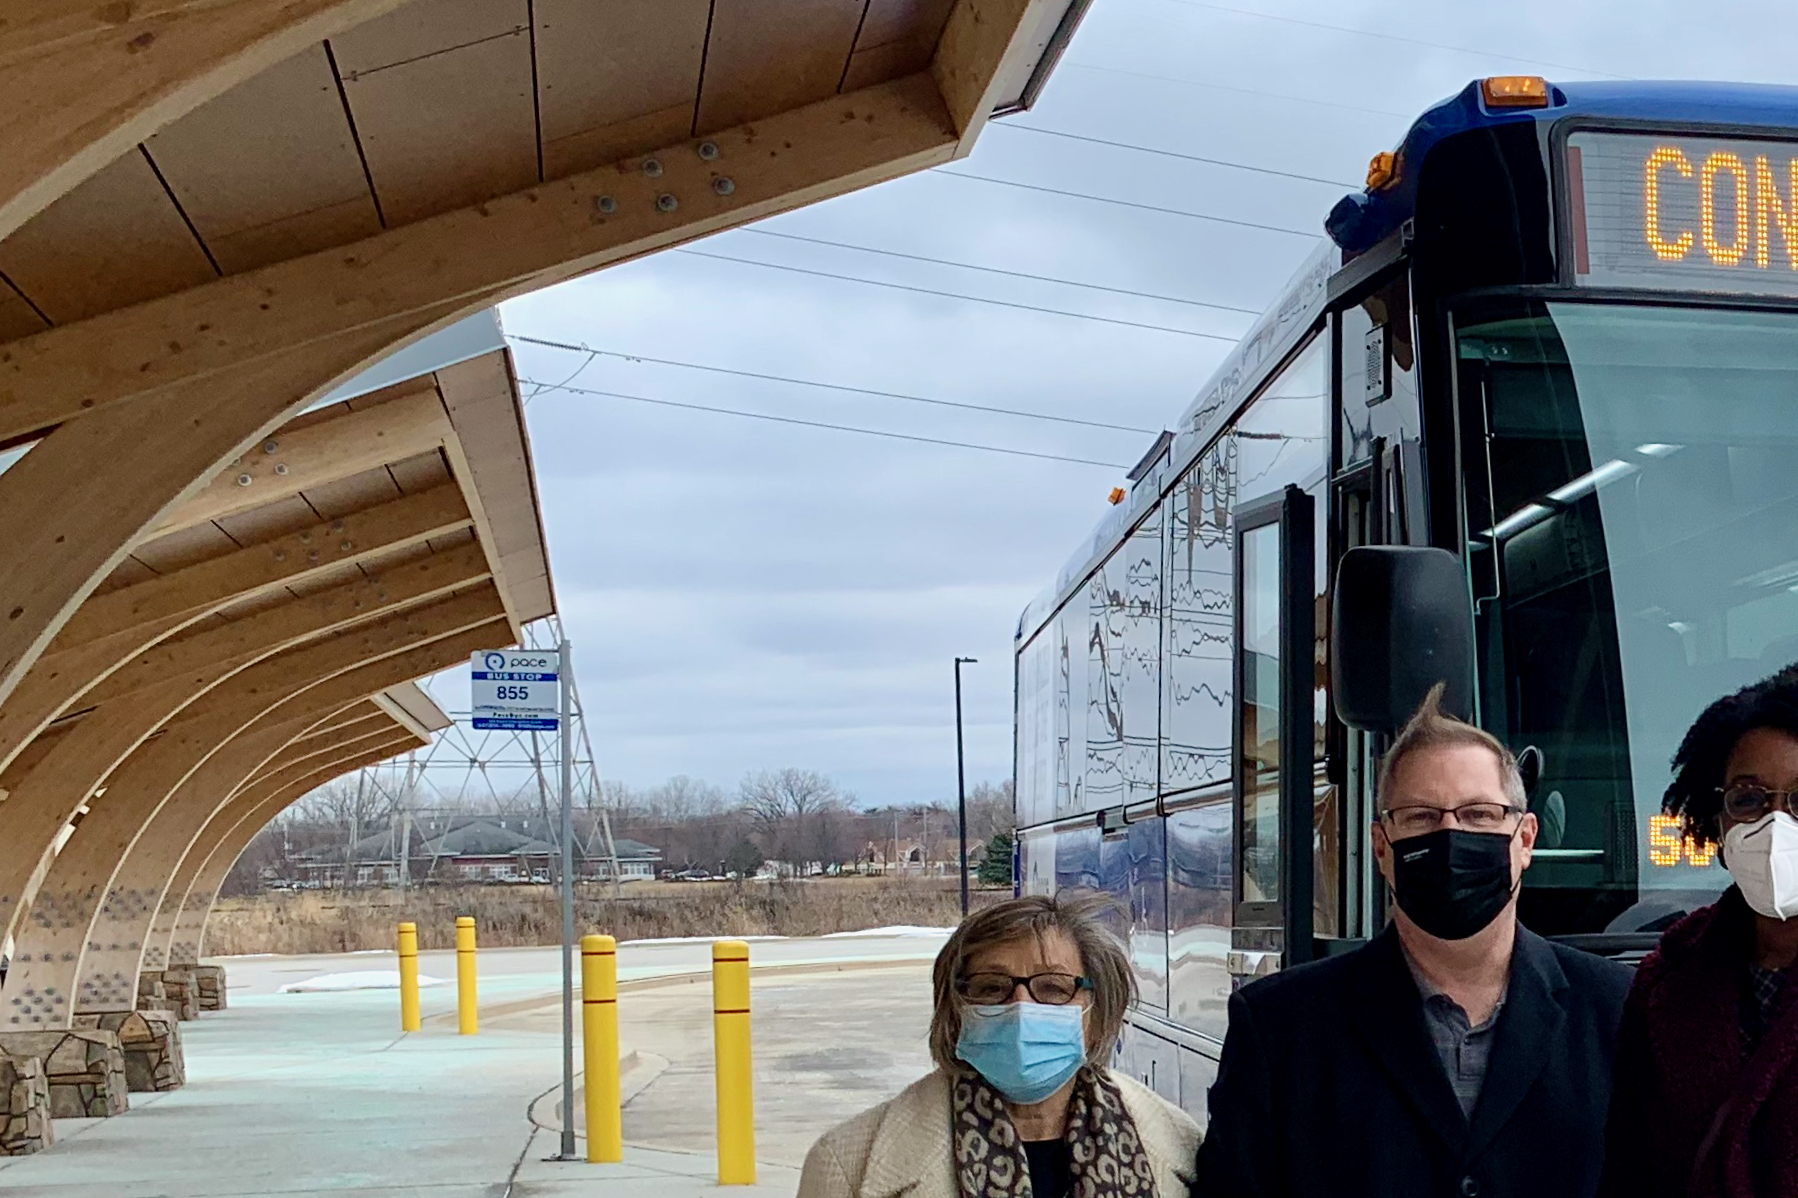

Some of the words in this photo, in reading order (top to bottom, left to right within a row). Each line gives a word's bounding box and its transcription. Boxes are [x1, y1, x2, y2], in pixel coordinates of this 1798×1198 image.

[510, 658, 547, 668] pace
[487, 673, 510, 681] BUS
[513, 673, 542, 681] STOP
[497, 686, 529, 700] 855
